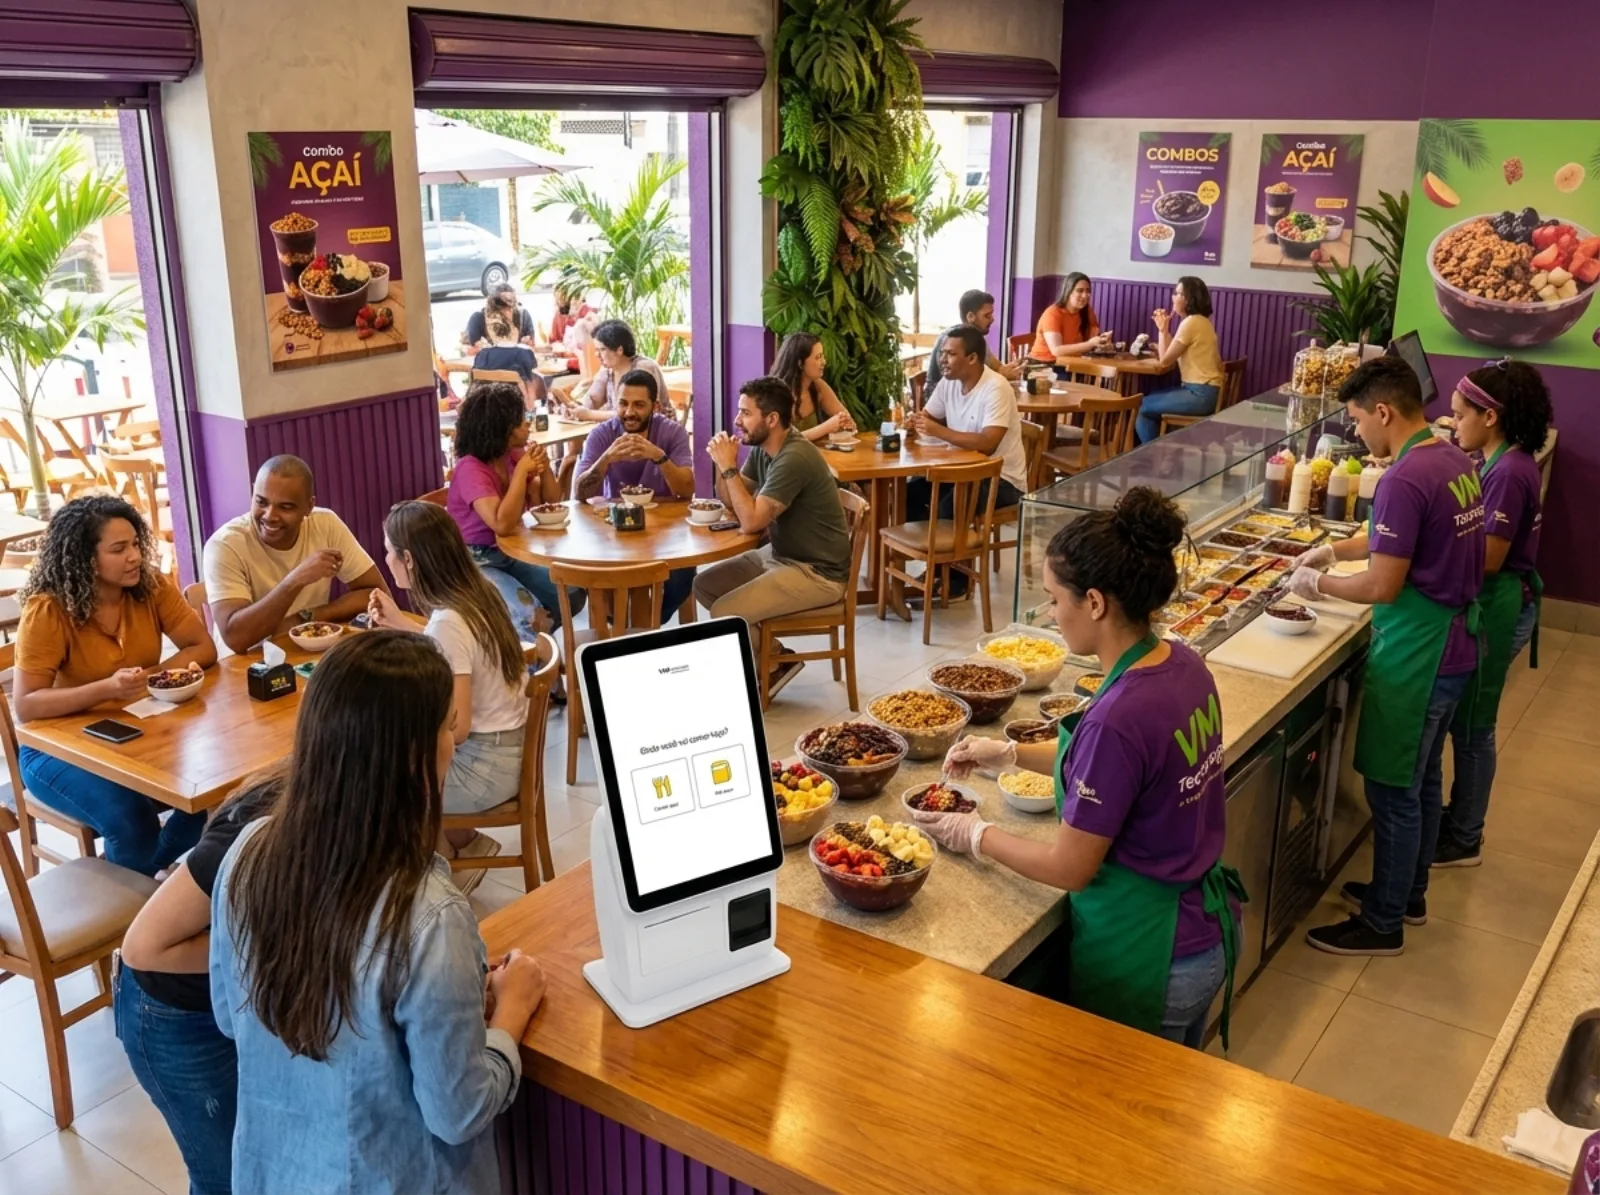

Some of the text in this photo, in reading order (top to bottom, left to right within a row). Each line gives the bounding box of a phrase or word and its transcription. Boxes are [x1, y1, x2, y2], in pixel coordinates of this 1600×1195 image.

[1146, 147, 1219, 162] COMBOS
[1282, 147, 1337, 173] AÇAÍ
[289, 152, 362, 196] AÇAÍ
[1174, 692, 1221, 768] VM
